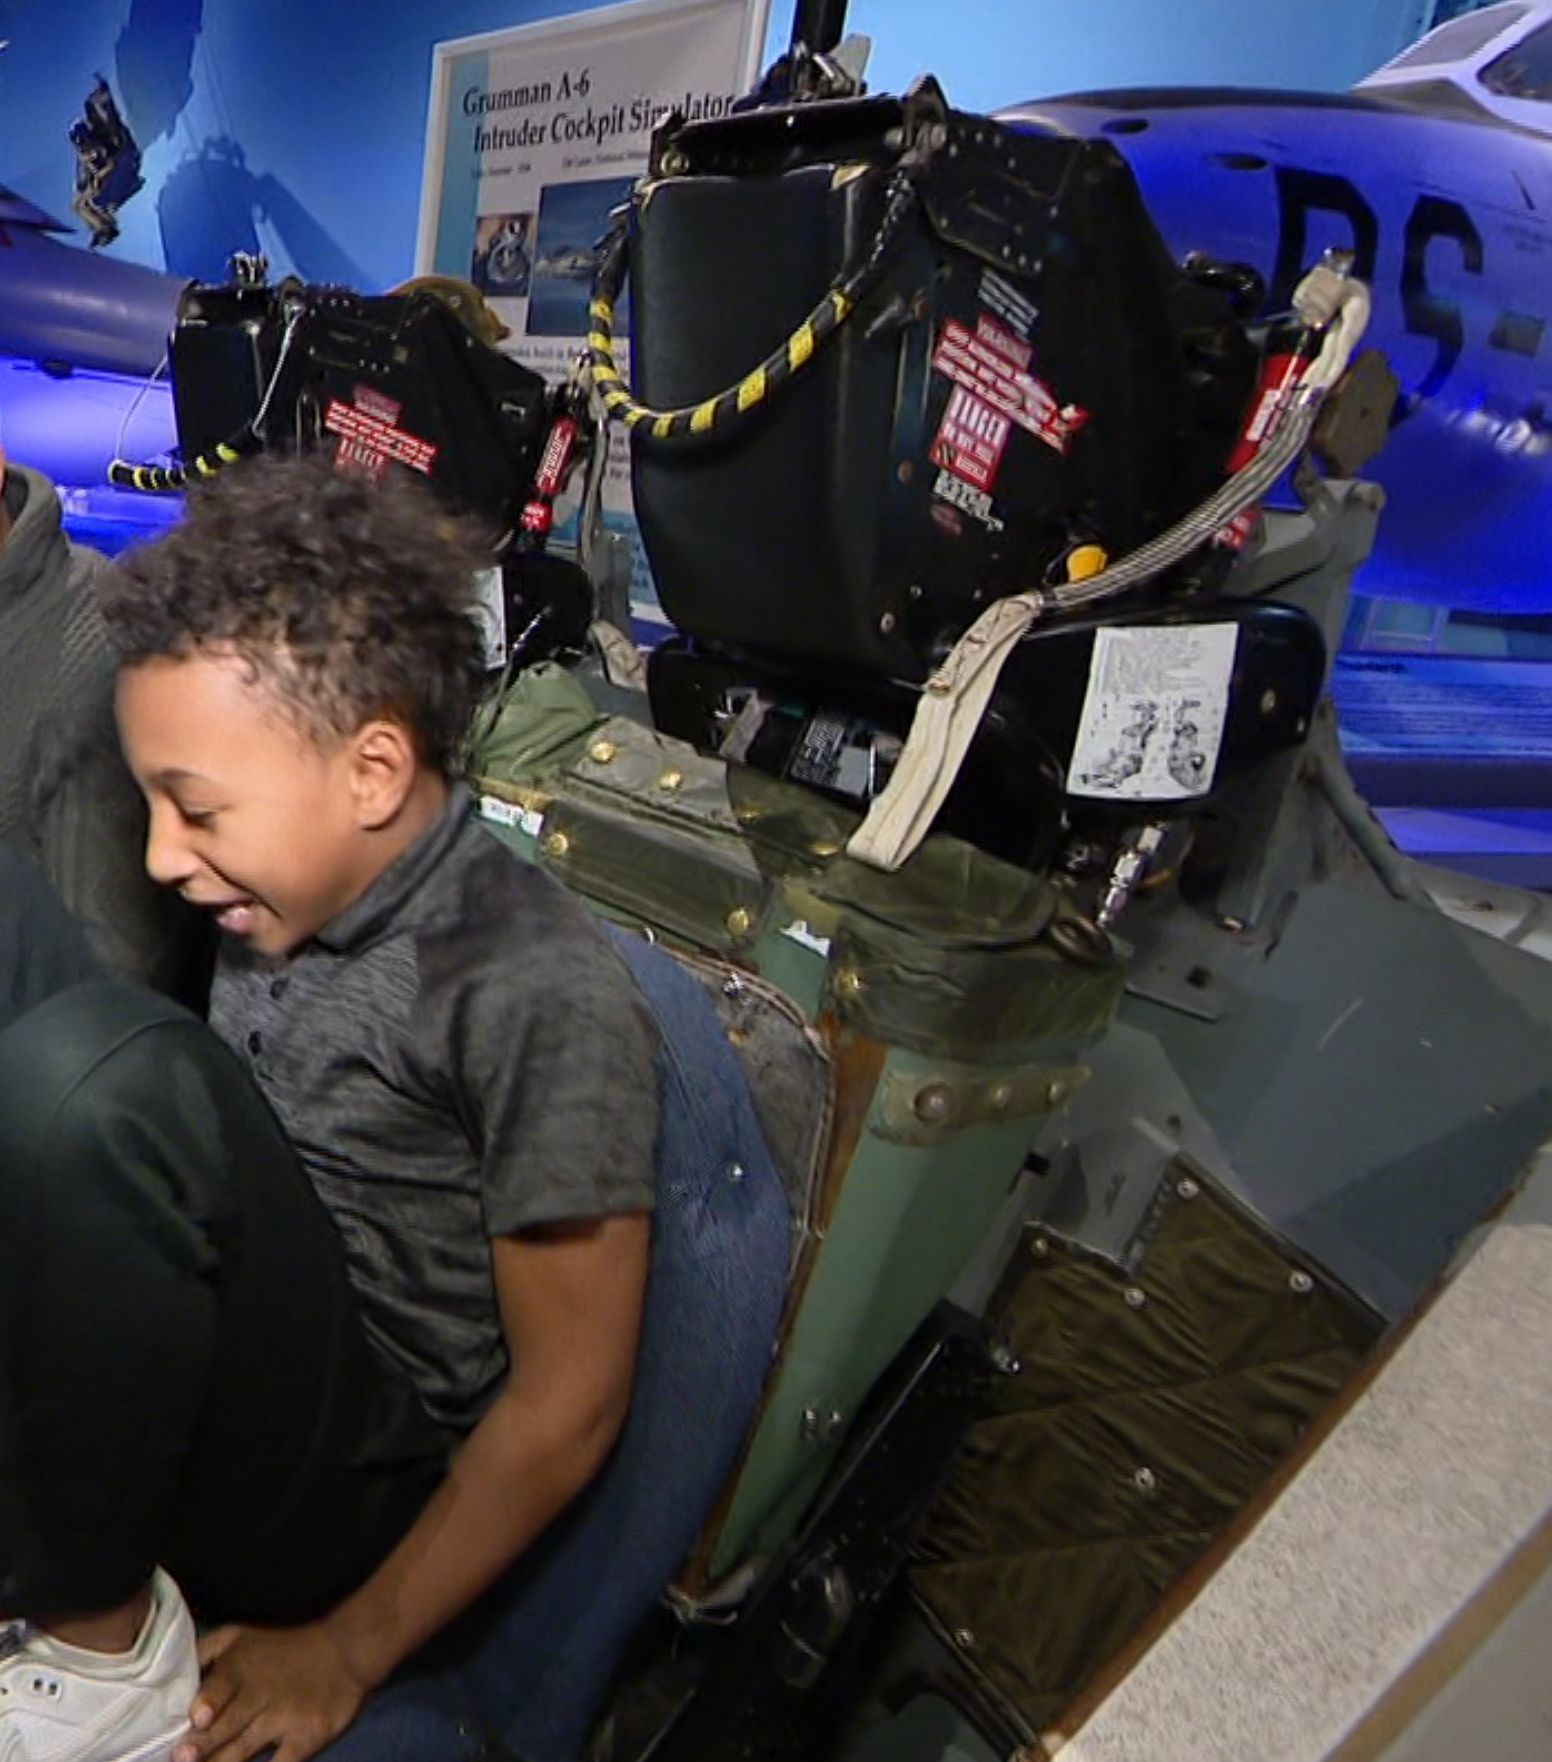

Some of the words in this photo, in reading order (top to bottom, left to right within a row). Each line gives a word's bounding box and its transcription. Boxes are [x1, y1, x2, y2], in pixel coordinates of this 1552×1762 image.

[462, 81, 551, 117] Grumman
[557, 68, 591, 99] A-6
[474, 117, 547, 153] Intruder
[551, 102, 625, 147] Cockpit
